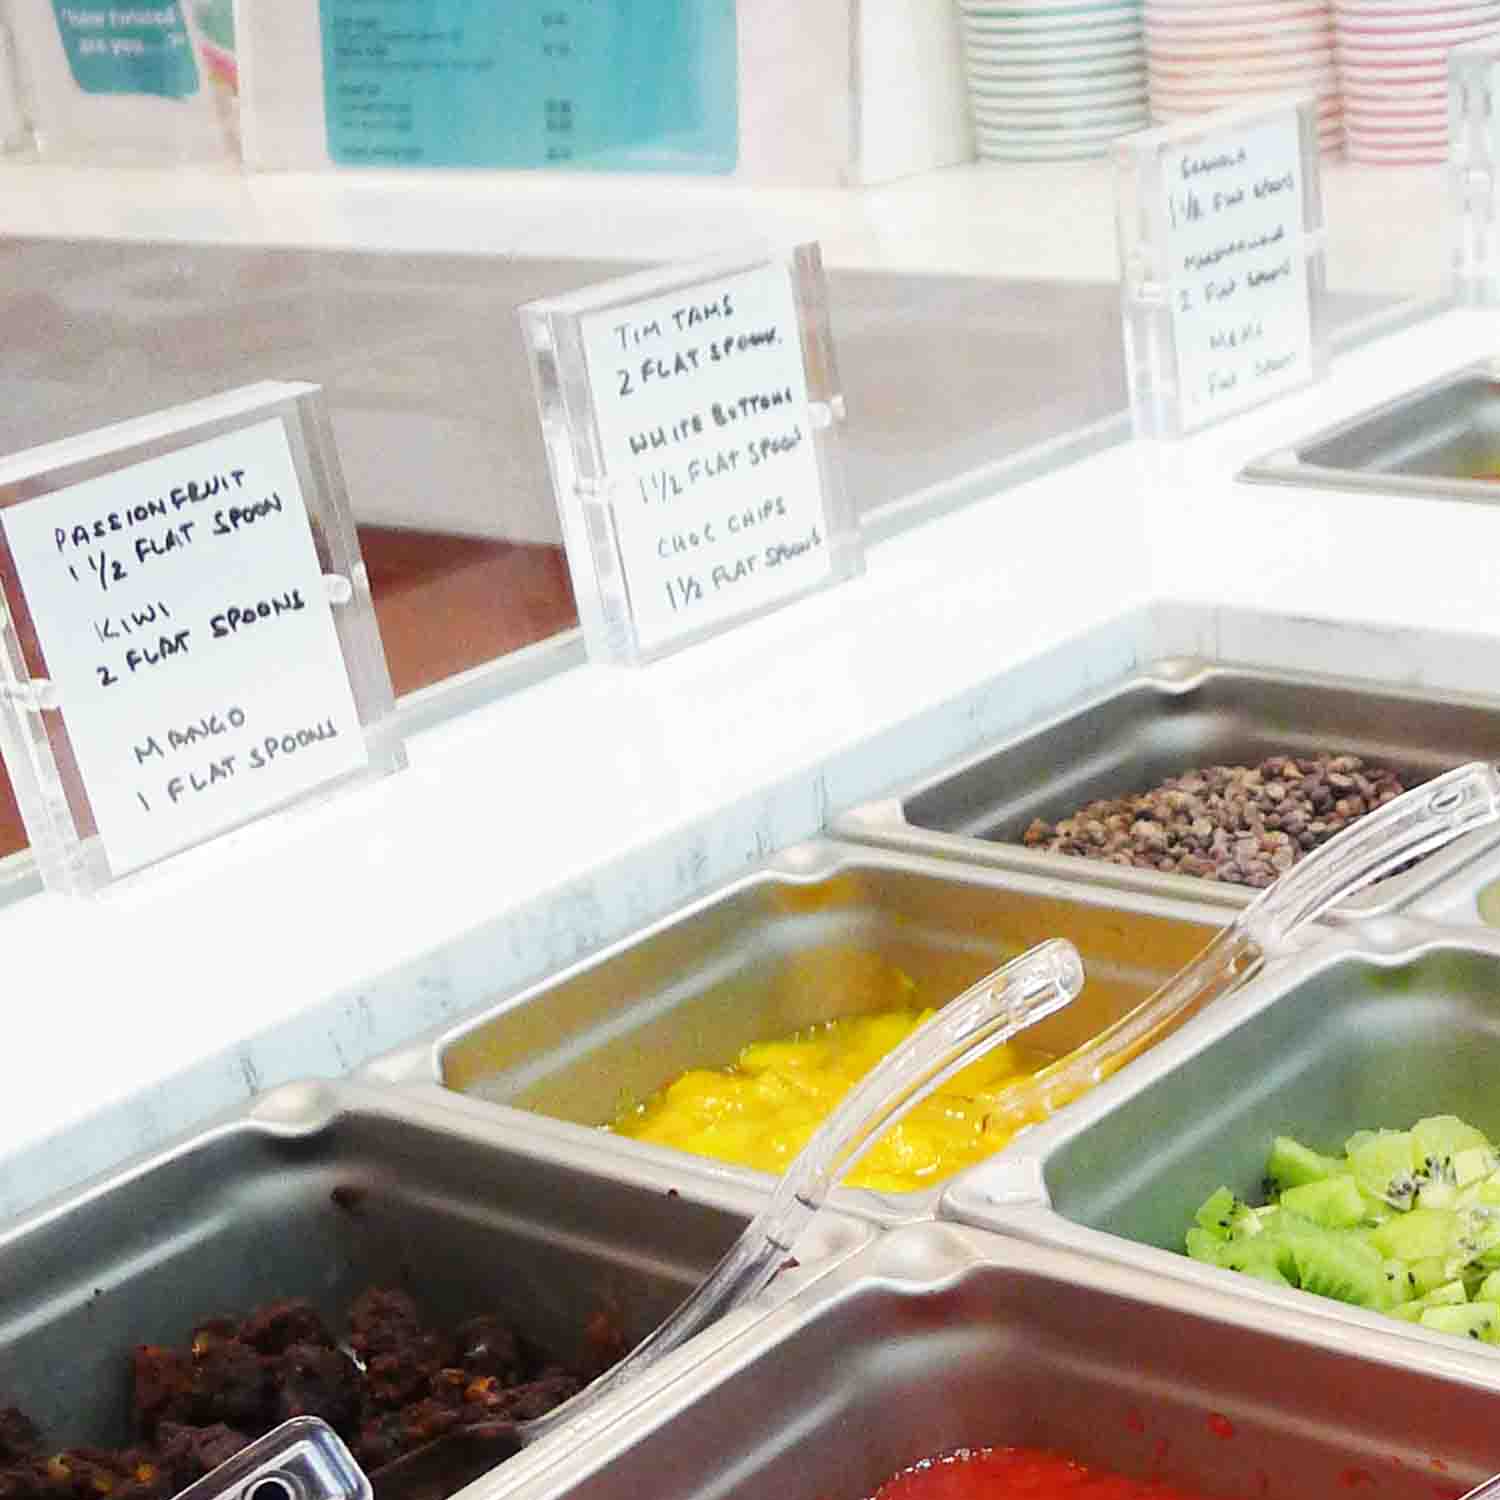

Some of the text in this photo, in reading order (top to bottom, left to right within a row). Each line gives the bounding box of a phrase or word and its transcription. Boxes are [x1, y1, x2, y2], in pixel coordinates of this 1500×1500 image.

[614, 294, 735, 352] TIM TAMS
[616, 369, 634, 397] 2
[640, 349, 699, 384] FLAT
[629, 415, 704, 455] WHITE
[687, 450, 740, 486] FLAT
[55, 468, 246, 552] PASSIONFRUIT
[69, 564, 80, 584] 1
[135, 521, 196, 564] FLAT
[213, 494, 283, 538] SPOON
[656, 496, 786, 559] CHOC CHIPS
[711, 554, 757, 591] FLAT
[95, 601, 172, 644] KIWI
[96, 589, 305, 688] 2 FLAT SPOONS
[133, 706, 247, 766] MANGO
[136, 717, 338, 812] 1 FLAT SPOONS
